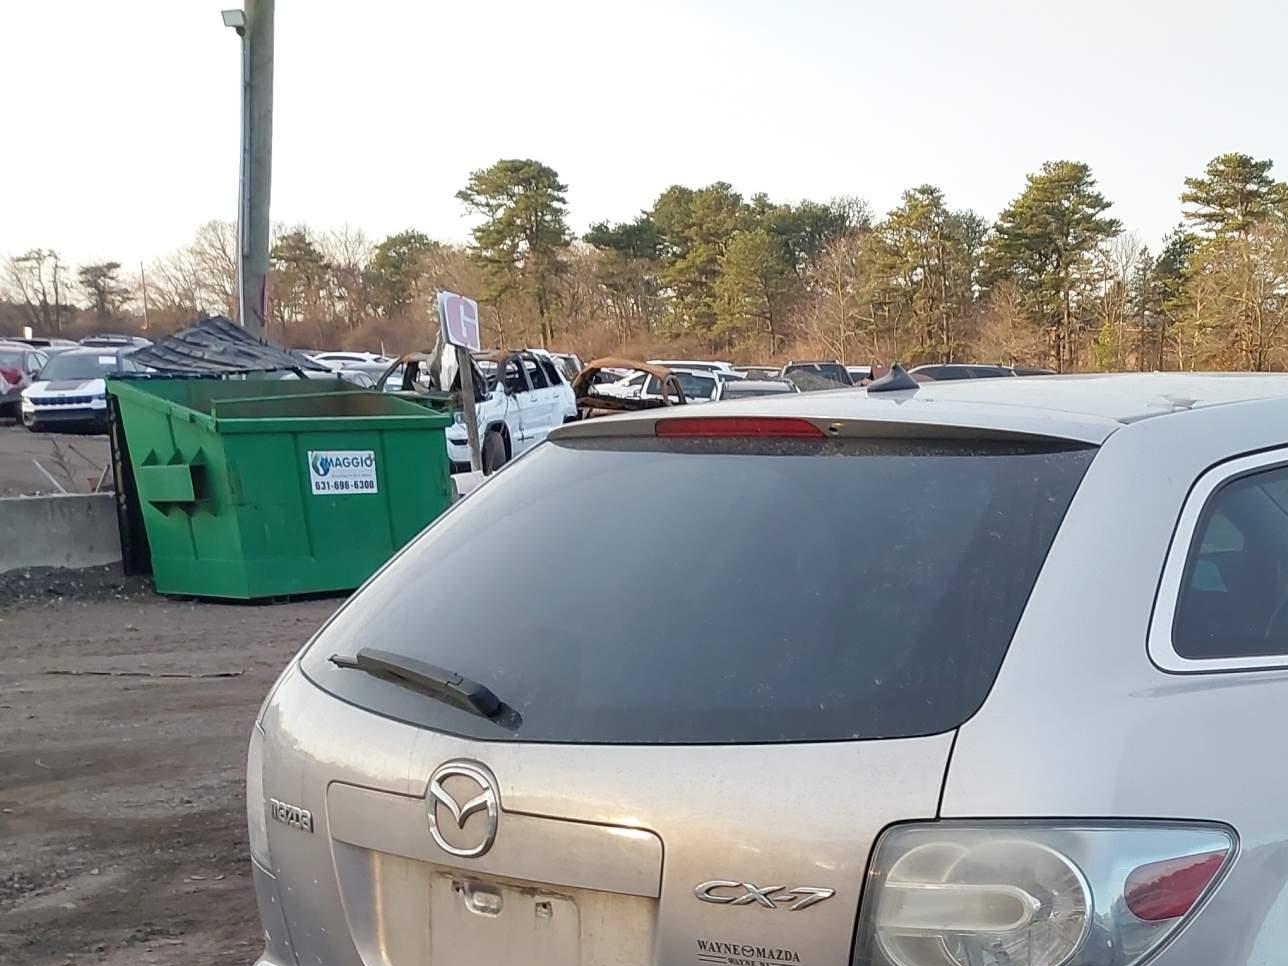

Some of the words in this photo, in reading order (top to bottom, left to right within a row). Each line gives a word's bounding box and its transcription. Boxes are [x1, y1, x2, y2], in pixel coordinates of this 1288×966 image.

[326, 456, 373, 468] MAGGIO
[695, 880, 836, 912] CX-7
[697, 939, 741, 956] WAYNE
[756, 946, 801, 963] MAZDA
